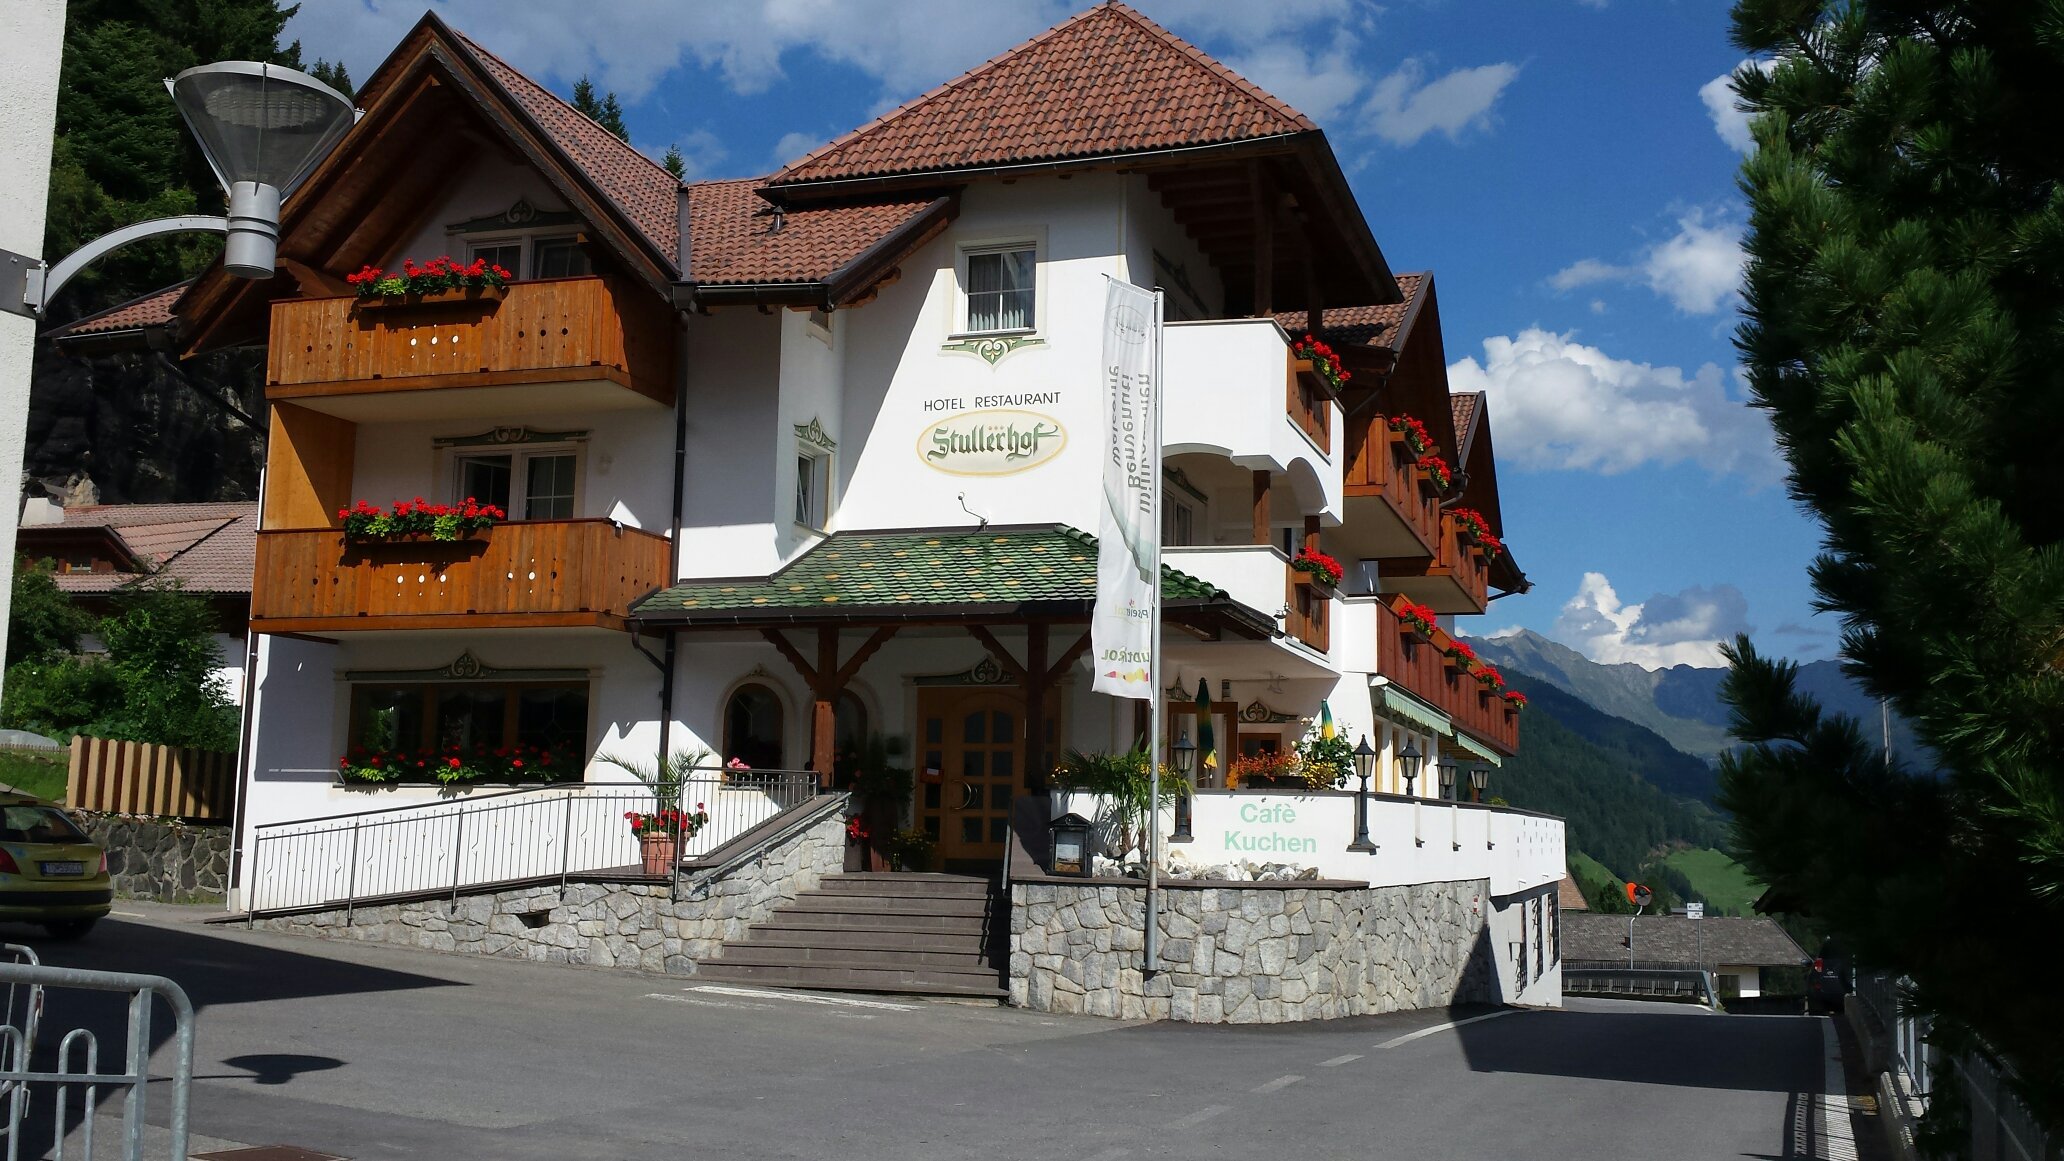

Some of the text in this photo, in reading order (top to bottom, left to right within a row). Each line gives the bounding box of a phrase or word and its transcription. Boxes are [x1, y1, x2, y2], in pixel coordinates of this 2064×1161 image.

[924, 391, 1061, 412] HOTEL RESTAURANT
[1240, 803, 1296, 824] Cafè
[1224, 830, 1317, 853] Kuchen
